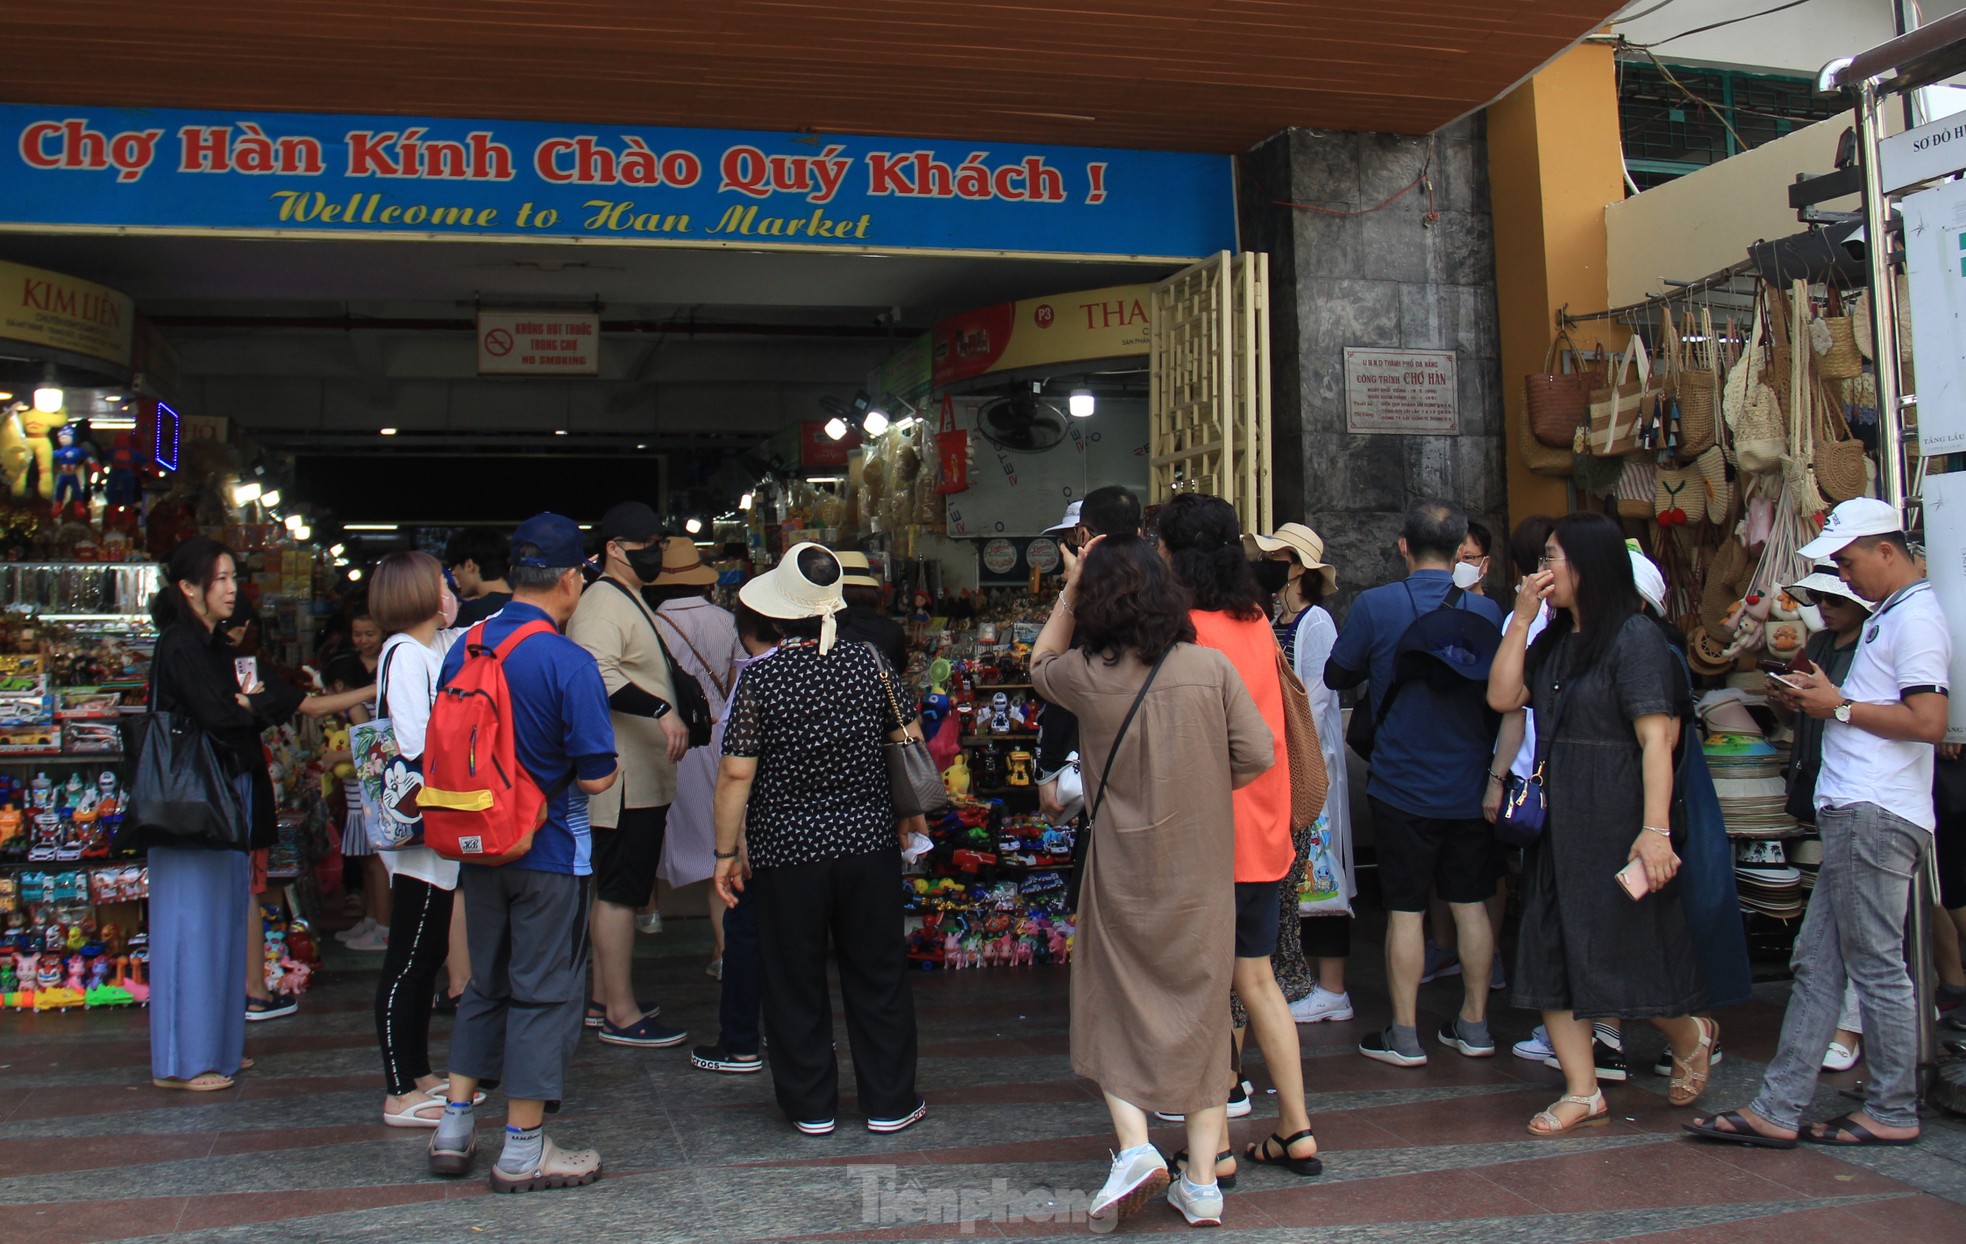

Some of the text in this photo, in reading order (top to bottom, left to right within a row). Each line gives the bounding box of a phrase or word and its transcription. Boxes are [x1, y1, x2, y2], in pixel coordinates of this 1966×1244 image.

[19, 119, 164, 183] Chợ
[177, 121, 327, 175] Hàn
[345, 127, 517, 181] Kính
[534, 134, 703, 188] Chào
[718, 144, 856, 203] Quý
[864, 151, 1067, 202] Khách
[269, 190, 873, 240] Wellcome to Han Market
[22, 277, 77, 318] KIM
[1038, 307, 1052, 321] P3
[514, 321, 544, 335] KHÔNG
[565, 320, 592, 336] THUỐC
[530, 339, 557, 352] TRONG
[522, 355, 586, 366] NO SMOKING
[1356, 370, 1446, 387] CÔNG TRÌNH CHỢ HÀN
[691, 1057, 720, 1070] crocs
